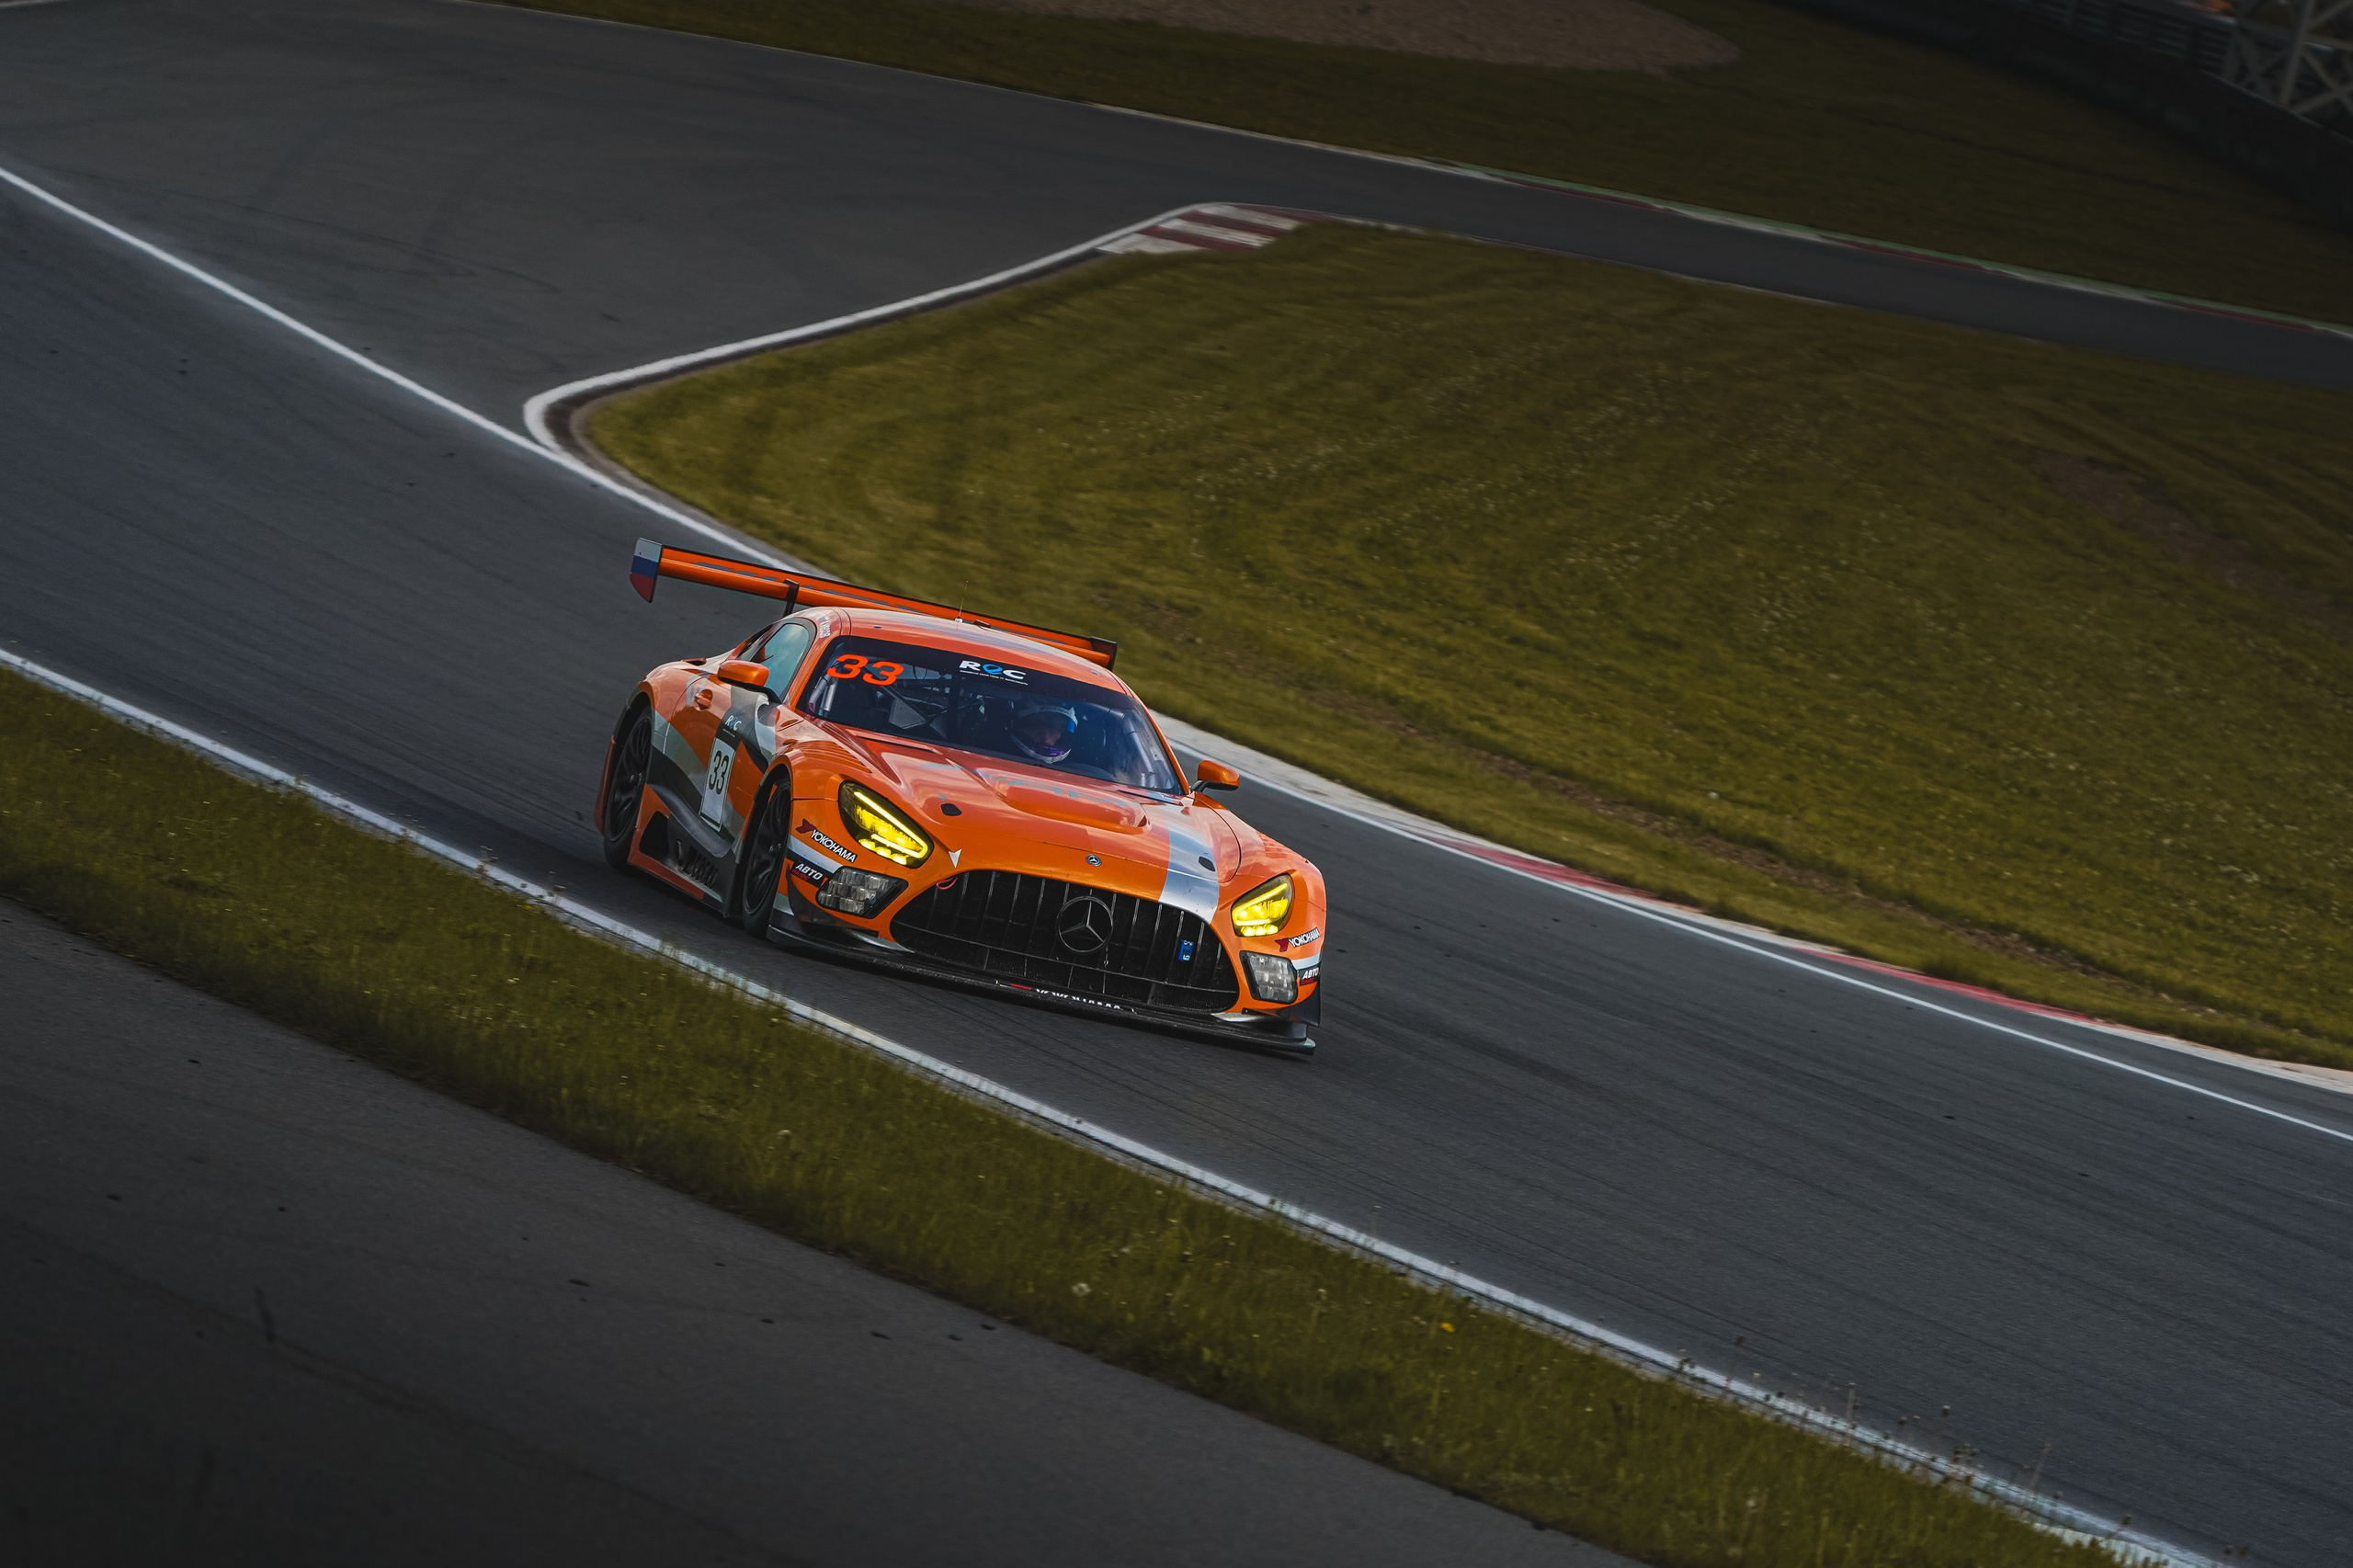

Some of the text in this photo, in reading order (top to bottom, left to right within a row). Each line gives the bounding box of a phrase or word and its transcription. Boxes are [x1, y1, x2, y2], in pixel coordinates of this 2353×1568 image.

[827, 653, 904, 687] 33
[708, 749, 730, 795] 33
[810, 829, 857, 863] YOKOHAMA
[795, 863, 824, 881] АВТО
[1289, 927, 1321, 948] YOKOHAMA
